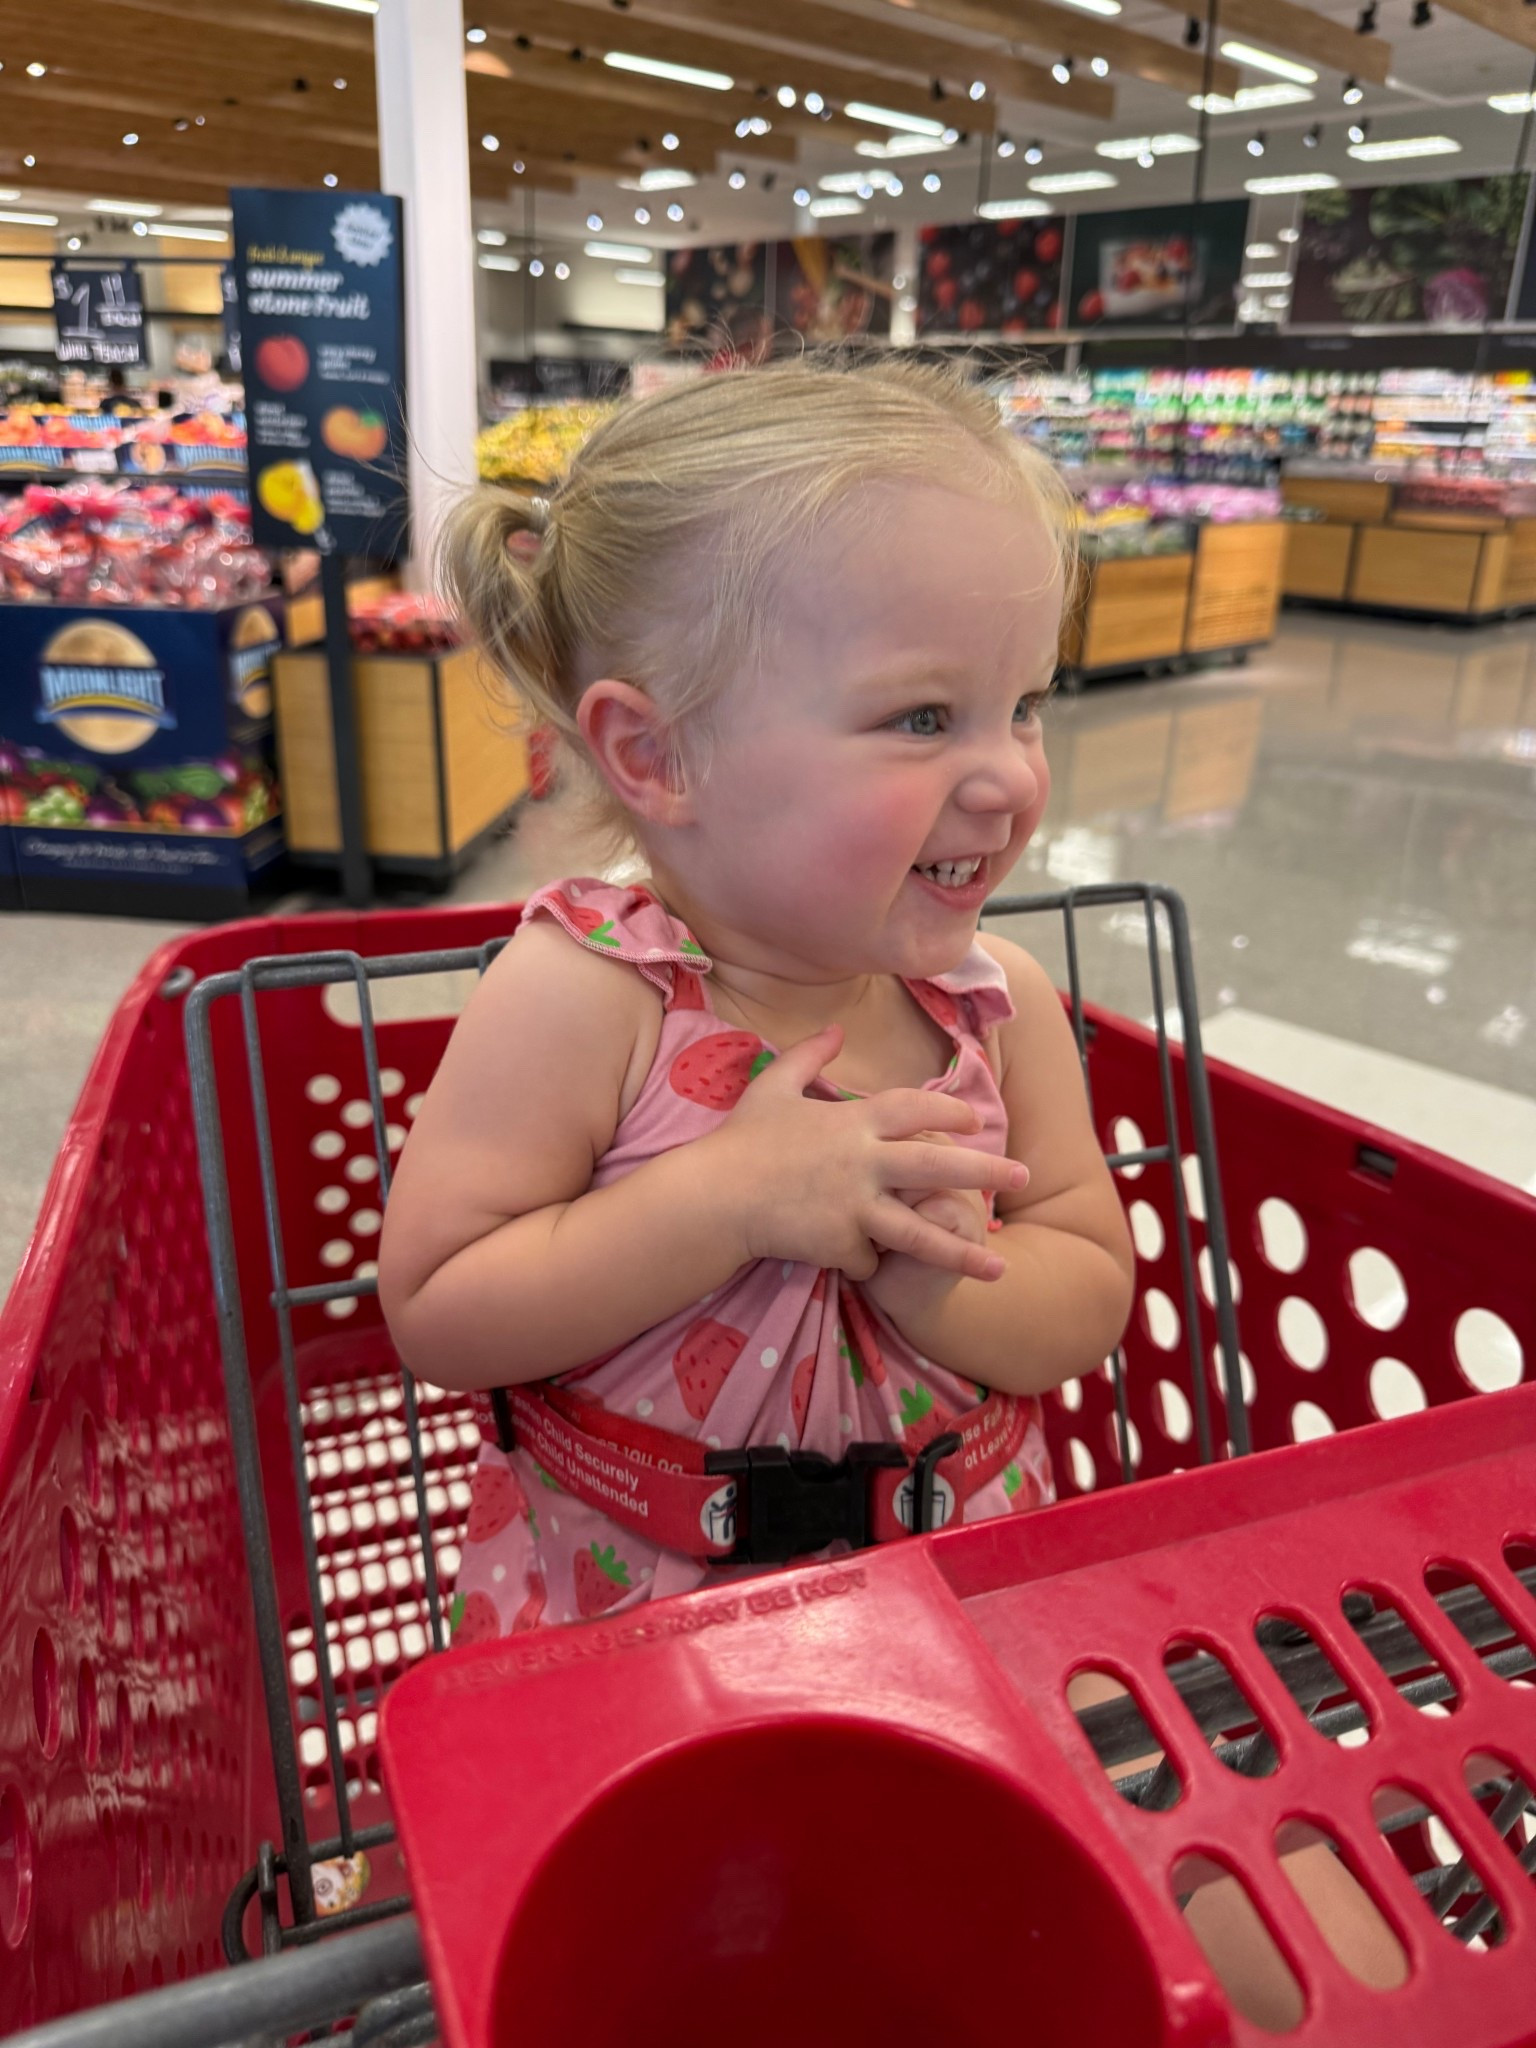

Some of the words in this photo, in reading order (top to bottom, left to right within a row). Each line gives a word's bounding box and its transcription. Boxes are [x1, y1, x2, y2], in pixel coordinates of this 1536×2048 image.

[537, 1431, 565, 1467] Child
[566, 1457, 649, 1518] Unattended
[543, 1417, 572, 1453] Child
[575, 1442, 639, 1492] Securely
[964, 1448, 979, 1470] ot
[665, 1600, 740, 1635] MAY
[745, 1586, 796, 1615] BE
[796, 1567, 868, 1606] HOT
